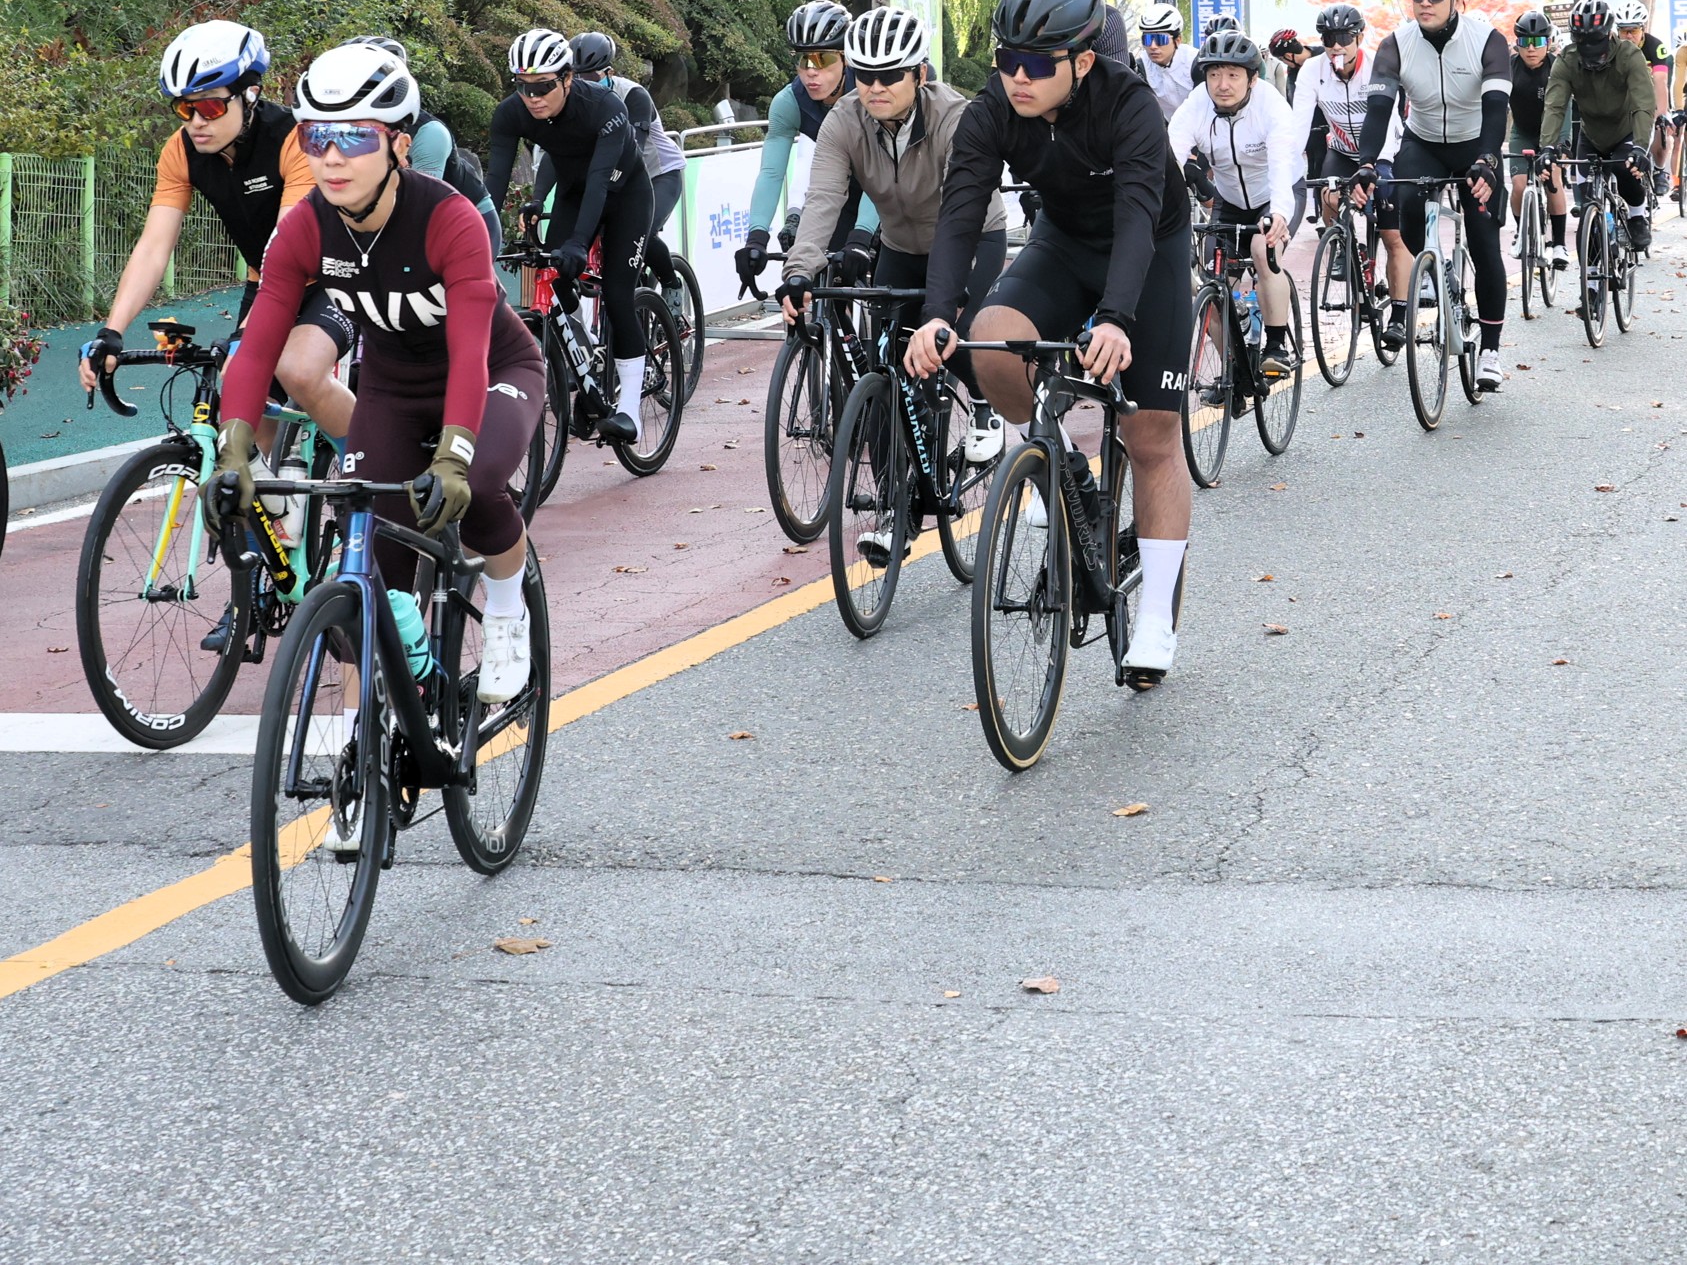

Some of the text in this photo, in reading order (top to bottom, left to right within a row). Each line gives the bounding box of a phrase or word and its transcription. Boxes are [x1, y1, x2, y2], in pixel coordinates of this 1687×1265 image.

[600, 111, 628, 137] APHA
[322, 256, 336, 276] SYN
[335, 259, 356, 268] Global
[551, 292, 597, 395] TREK
